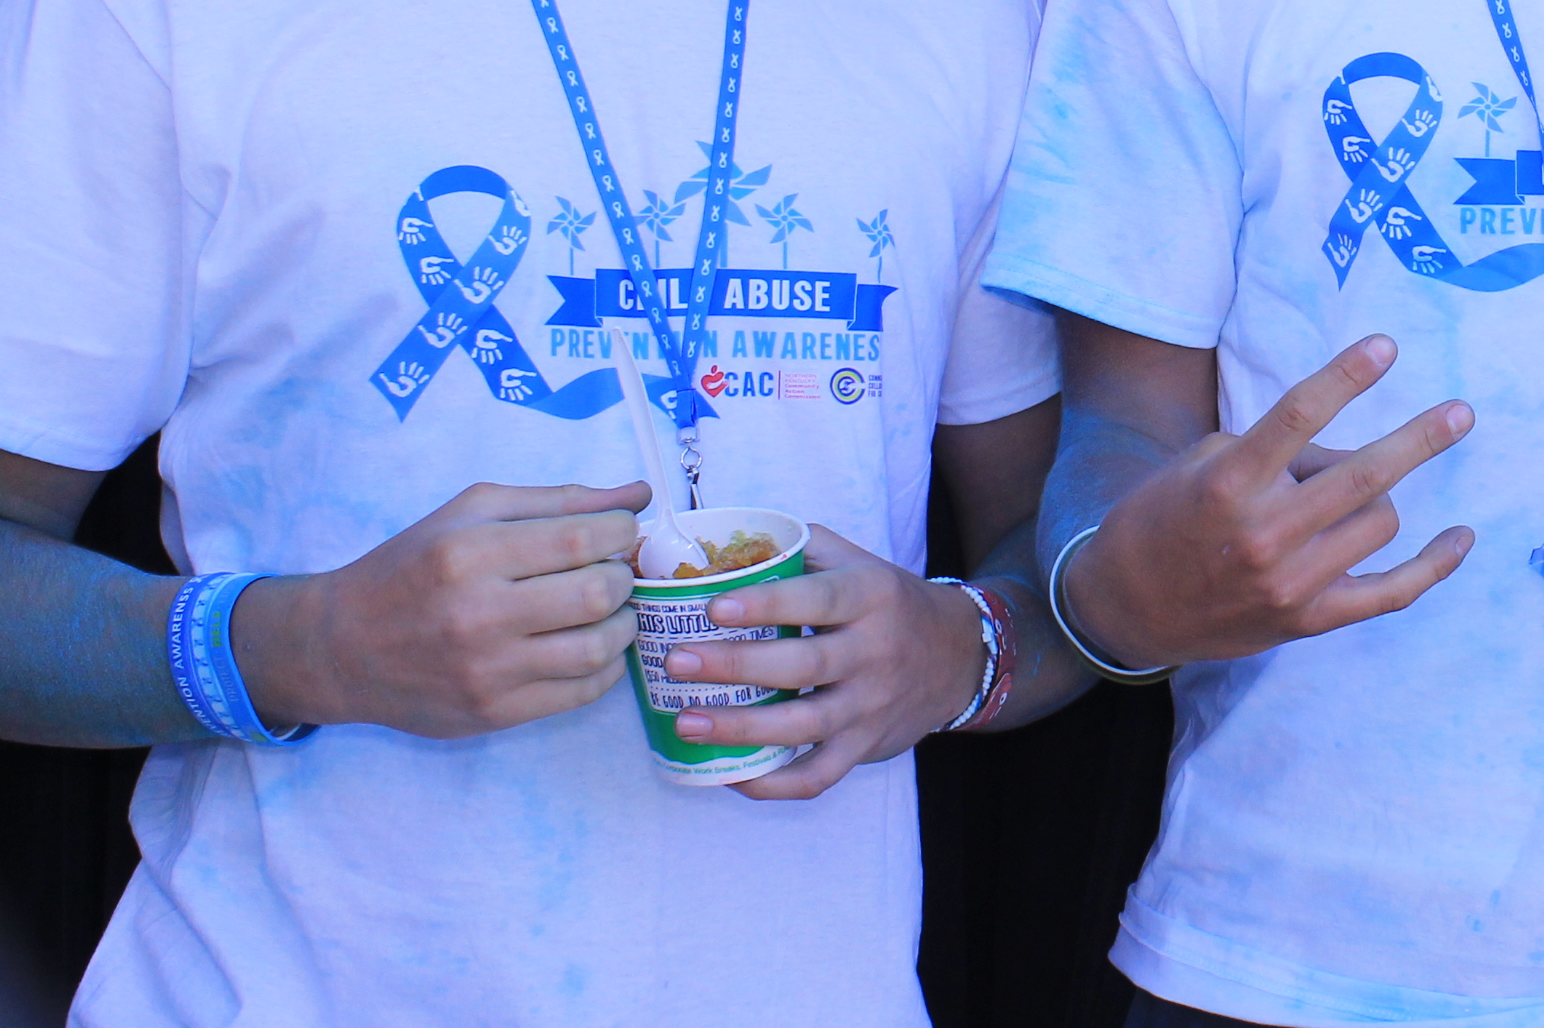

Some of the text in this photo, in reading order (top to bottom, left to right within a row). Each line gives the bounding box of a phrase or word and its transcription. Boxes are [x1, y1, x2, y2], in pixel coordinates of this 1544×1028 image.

[723, 278, 831, 312] ABUSE
[724, 371, 774, 398] CAC
[637, 613, 665, 634] HIS
